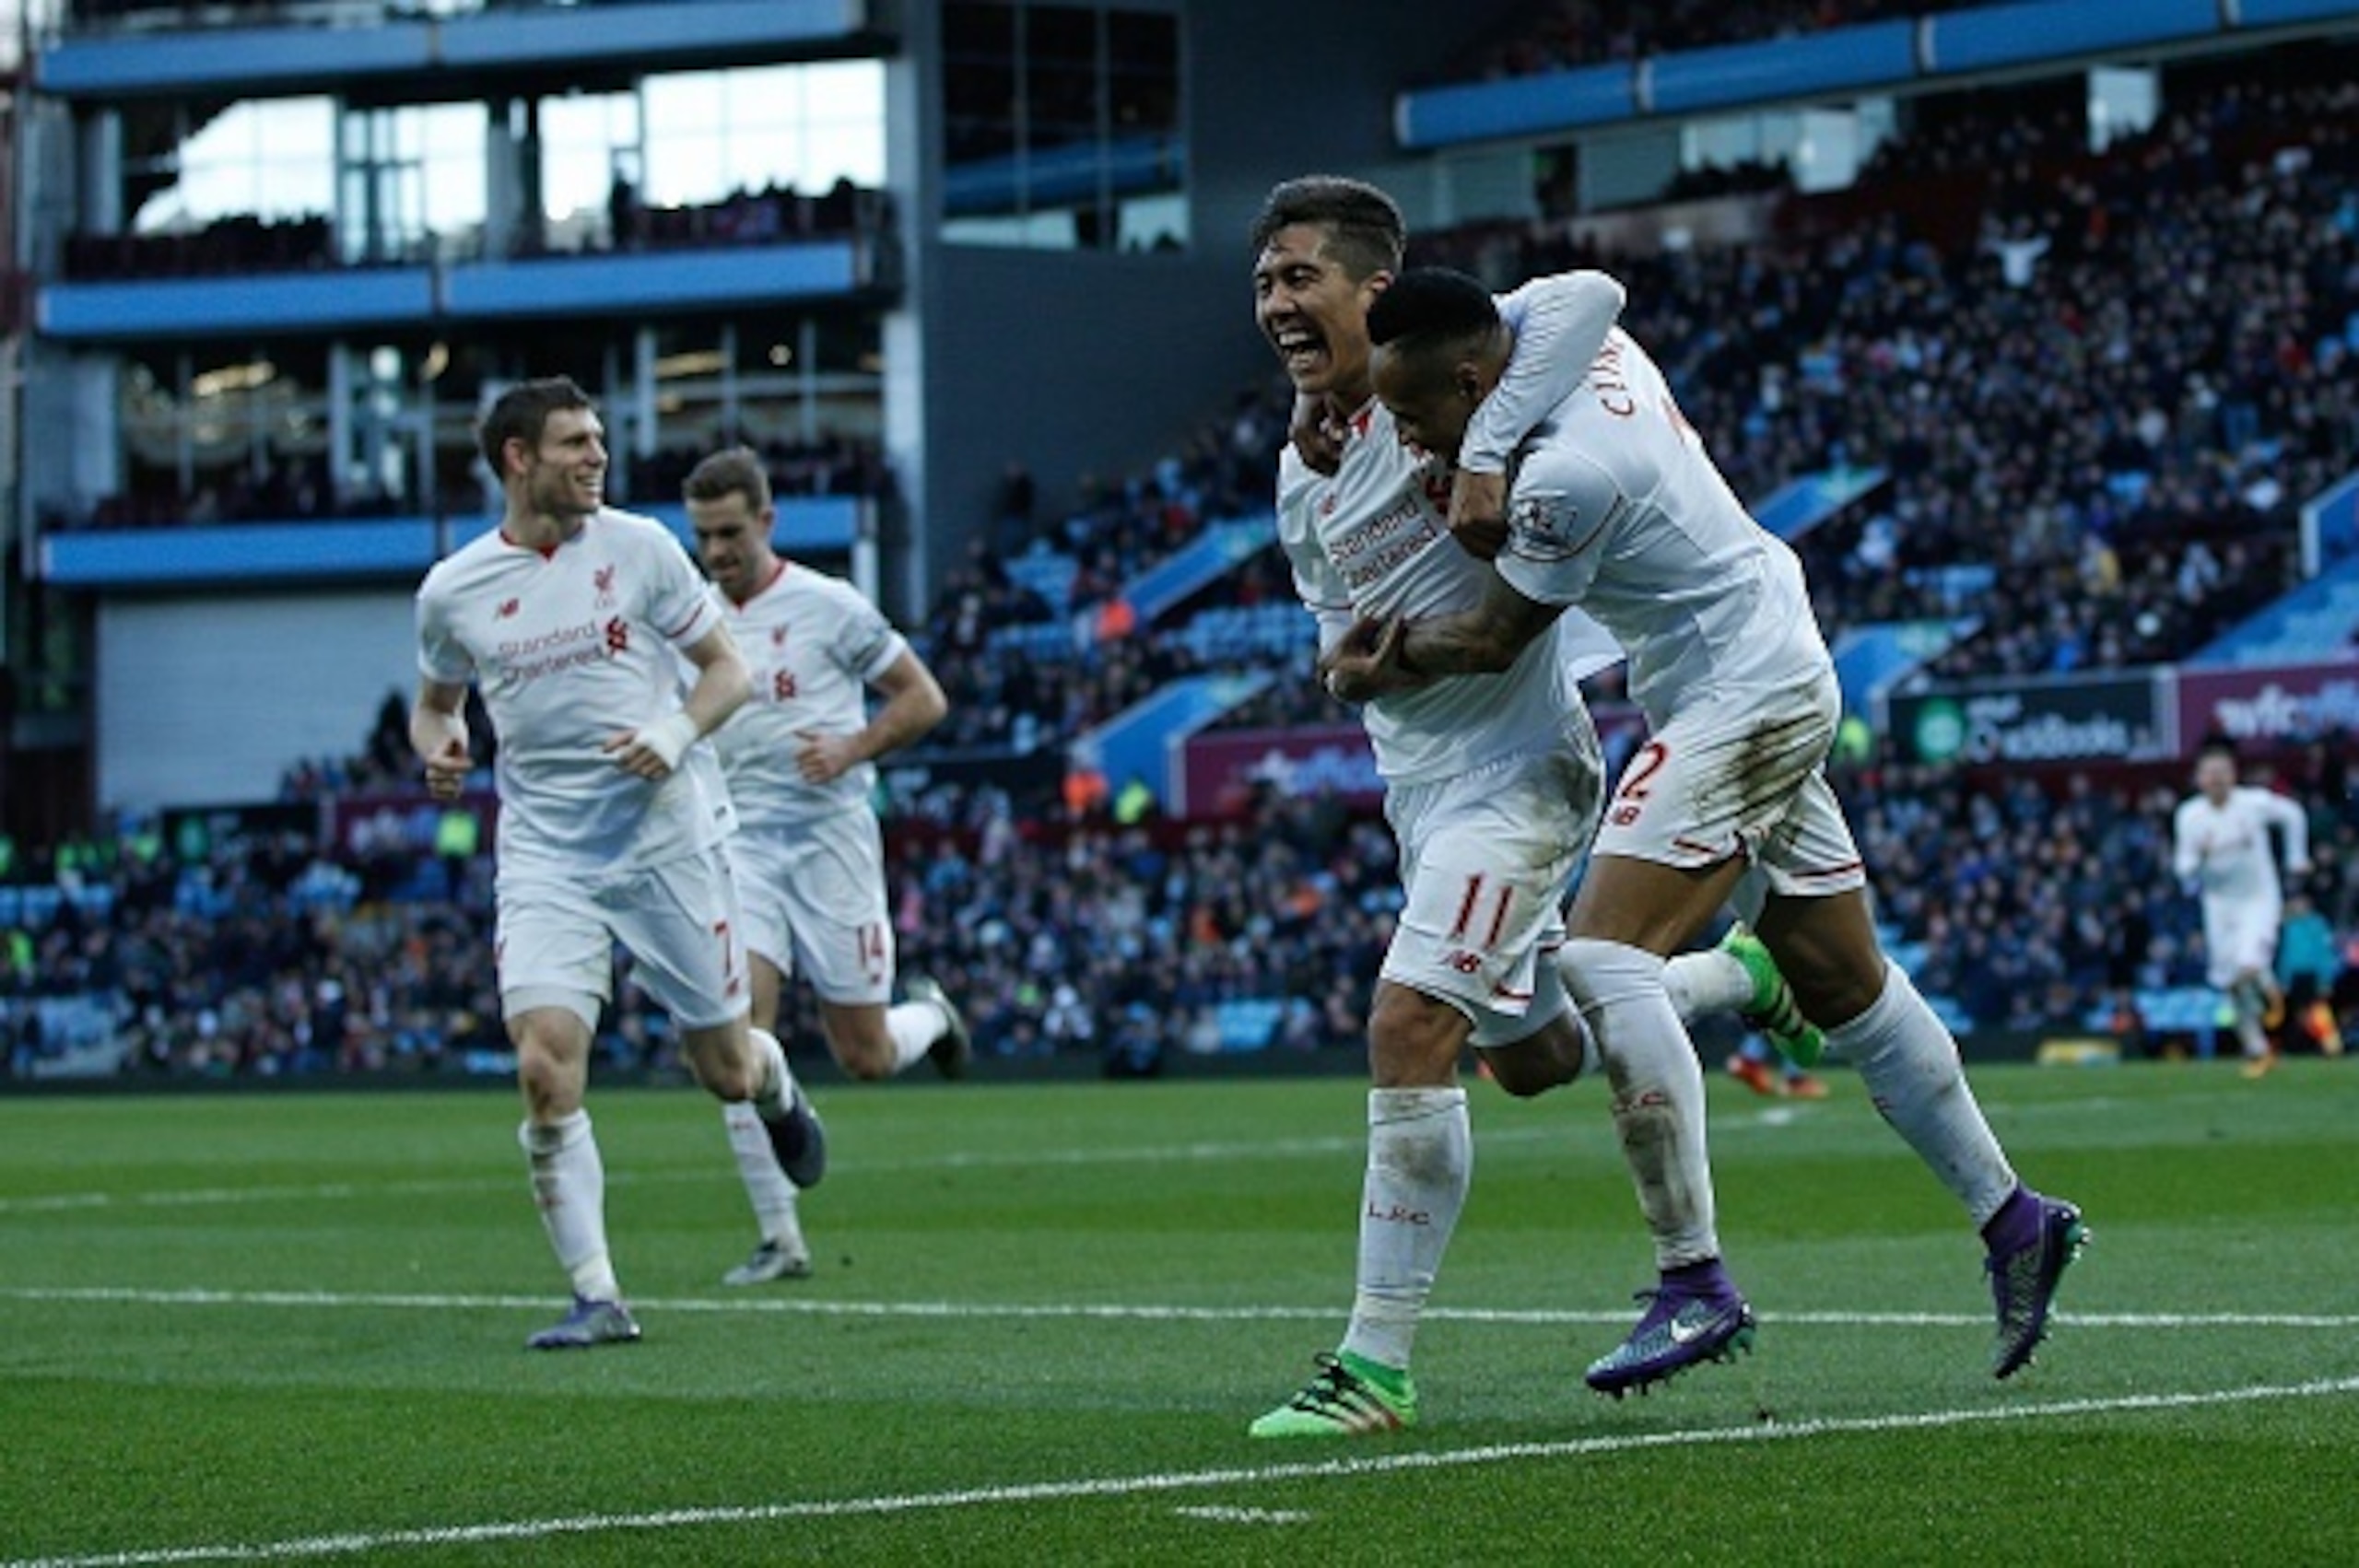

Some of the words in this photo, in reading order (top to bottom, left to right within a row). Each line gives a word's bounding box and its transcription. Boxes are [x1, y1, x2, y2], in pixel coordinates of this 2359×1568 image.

[499, 619, 596, 658] Standard
[499, 643, 604, 684] Chartered
[1621, 743, 1669, 798] 2
[1448, 872, 1513, 951] 11
[713, 919, 732, 977] 7
[857, 923, 883, 969] 14
